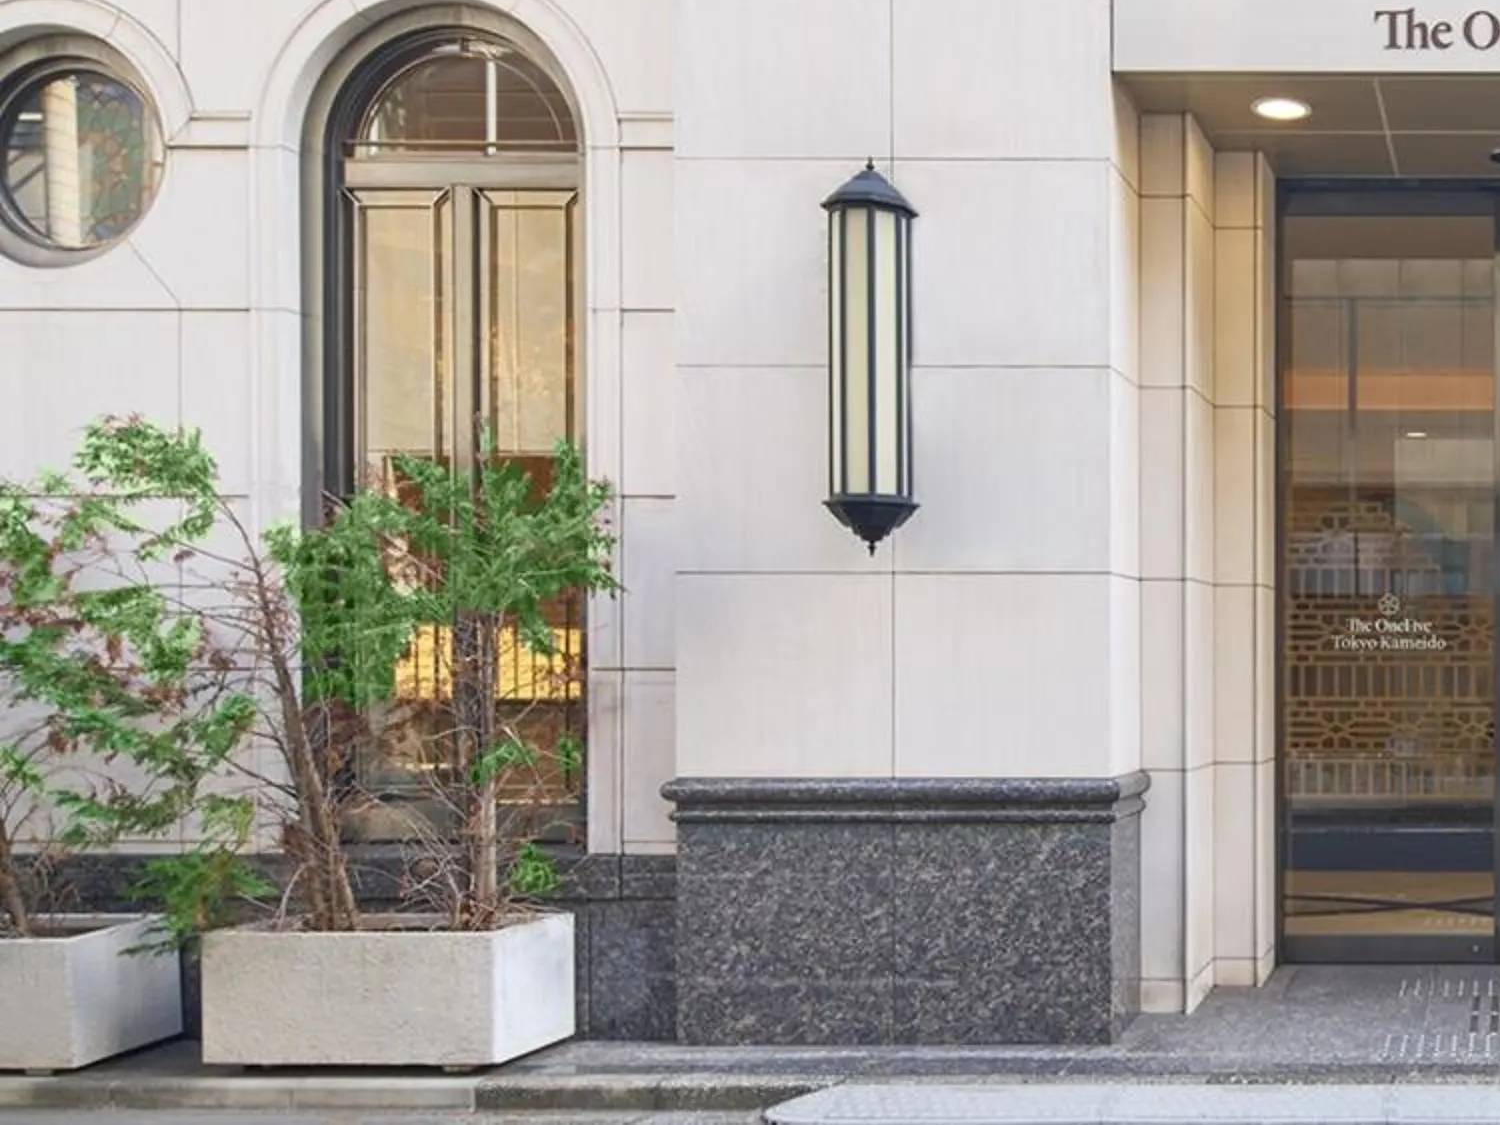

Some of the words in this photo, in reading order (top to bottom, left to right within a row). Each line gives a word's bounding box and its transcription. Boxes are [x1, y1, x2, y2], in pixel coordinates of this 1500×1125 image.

[1373, 7, 1454, 50] The
[1346, 618, 1373, 633] The
[1331, 634, 1379, 652] Tokyo
[1380, 634, 1447, 650] Kameido
